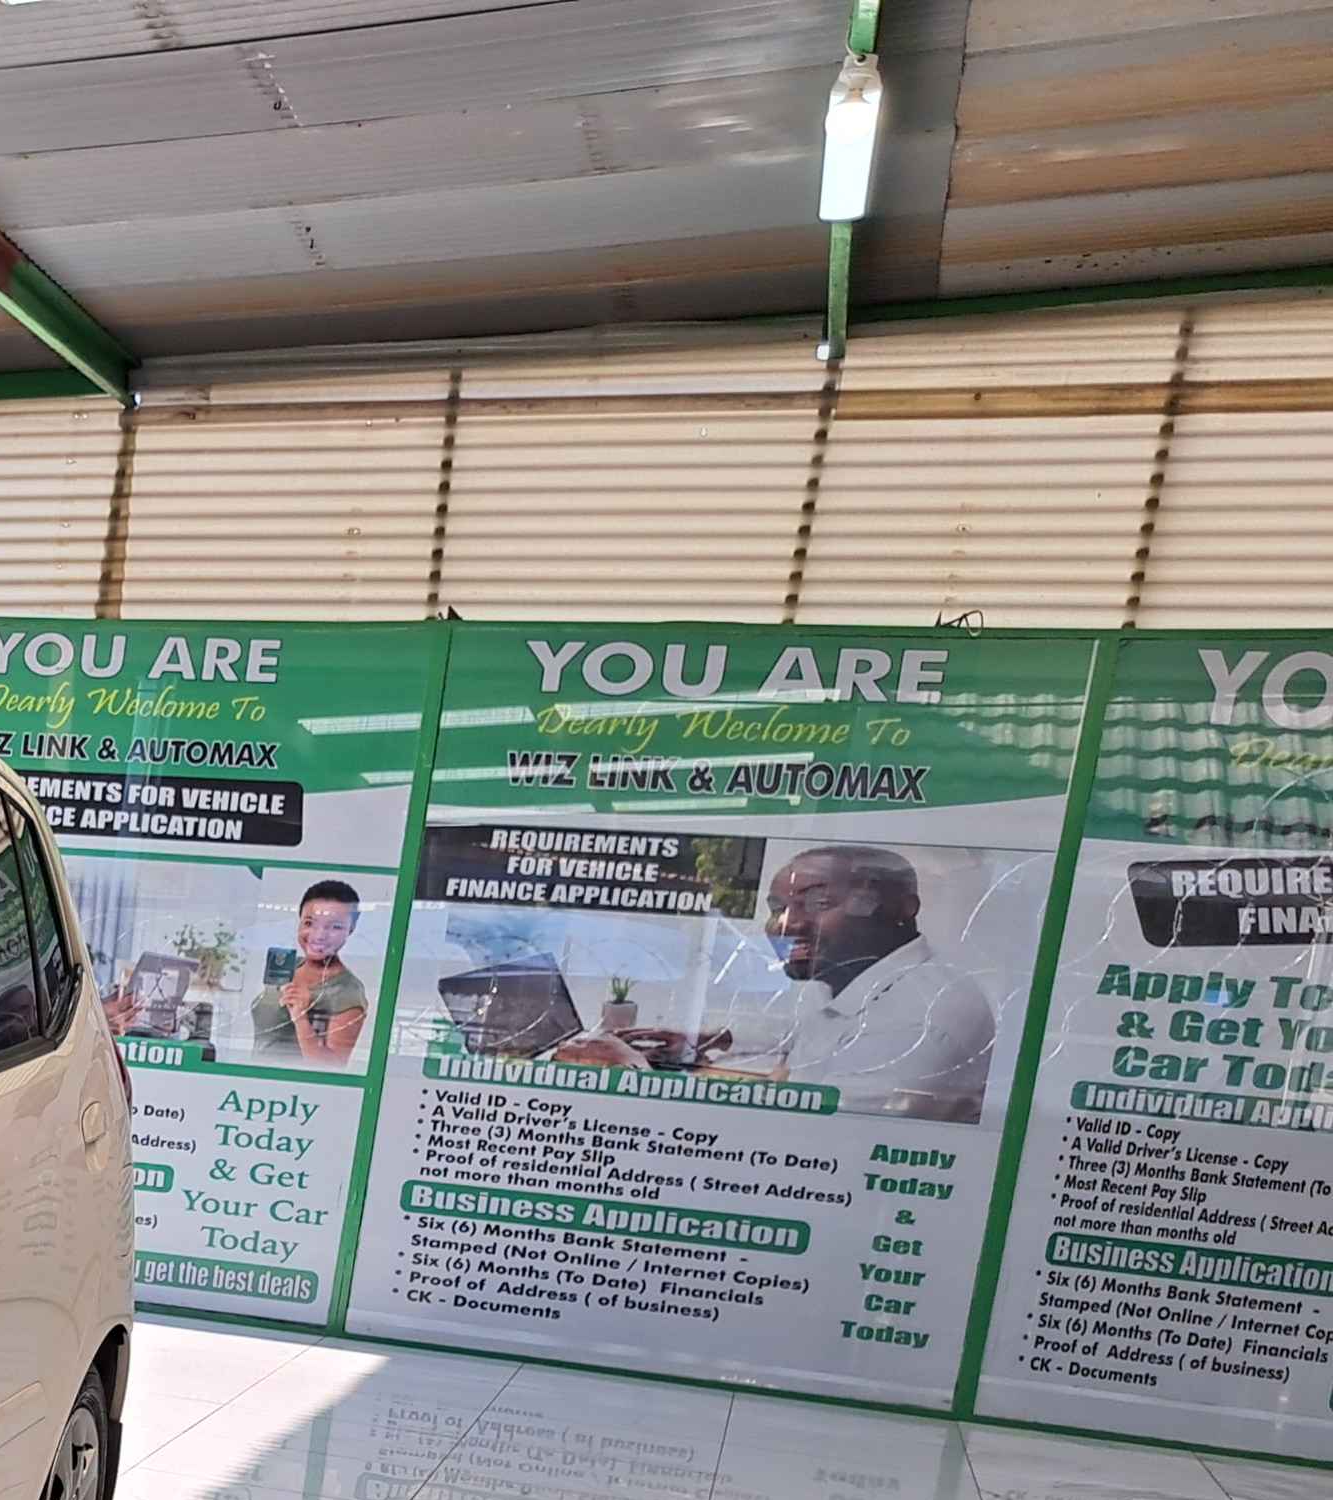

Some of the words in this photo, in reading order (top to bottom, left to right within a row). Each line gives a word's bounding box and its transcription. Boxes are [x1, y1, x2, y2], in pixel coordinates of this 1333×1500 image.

[148, 637, 282, 683] ARE
[527, 640, 729, 698] YOU
[758, 646, 950, 704] ARE
[86, 685, 221, 720] Weclome
[231, 696, 266, 721] To
[536, 702, 660, 753] Dearly
[676, 704, 850, 746] Weclome
[866, 717, 911, 747] To
[22, 734, 90, 759] LINK
[97, 737, 119, 762] &
[127, 738, 281, 769] AUTOMAX
[21, 775, 123, 804] EMENTS
[128, 783, 176, 807] FOR
[181, 787, 286, 816] VEHICLE
[507, 750, 580, 788] WIZ
[587, 753, 678, 793] LINK
[687, 763, 715, 794] &
[725, 758, 931, 803] AUTOMAX
[79, 807, 243, 842] APPLICATION
[489, 828, 680, 858] REQUIREMENTS
[506, 856, 553, 877] FOR
[558, 858, 660, 883] VEHICLE
[445, 878, 547, 902] FINANCE
[550, 883, 713, 913] APPLICATION
[1096, 963, 1256, 1009] Apply
[1117, 1010, 1155, 1039] &
[1168, 1009, 1265, 1048] Get
[1112, 1045, 1209, 1083] Car
[435, 1089, 482, 1106] Valid
[487, 1094, 507, 1108] ID
[527, 1098, 572, 1117] Copy
[438, 1056, 609, 1092] Individual
[616, 1067, 823, 1113] Application
[1085, 1083, 1245, 1121] Individual
[144, 1103, 186, 1122] Date)
[217, 1089, 320, 1126] Apply
[432, 1105, 445, 1118] A
[452, 1105, 498, 1123] Valid
[582, 1118, 651, 1138] License
[672, 1127, 718, 1147] Copy
[214, 1123, 315, 1160] Today
[430, 1119, 482, 1137] Three
[487, 1125, 512, 1142] (3)
[517, 1127, 585, 1146] Months
[591, 1135, 640, 1152] Bank
[646, 1140, 744, 1162] Statement
[750, 1150, 778, 1167] (To
[784, 1153, 838, 1175] Date)
[1076, 1116, 1113, 1134] Valid
[1114, 1120, 1132, 1136] ID
[1146, 1123, 1181, 1145] Copy
[427, 1133, 471, 1150] Most
[476, 1139, 537, 1157] Recent
[542, 1145, 576, 1164] Pay
[580, 1149, 616, 1167] Slip
[870, 1143, 957, 1170] Apply
[1070, 1135, 1082, 1151] A
[1086, 1137, 1123, 1155] Valid
[1185, 1147, 1238, 1167] License
[1254, 1153, 1290, 1176] Copy
[209, 1158, 238, 1182] &
[249, 1162, 310, 1190] Get
[419, 1167, 449, 1178] not
[454, 1170, 502, 1184] more
[507, 1172, 550, 1189] than
[555, 1180, 624, 1197] months
[630, 1185, 660, 1200] old
[425, 1149, 474, 1165] Proof
[484, 1154, 498, 1168] of
[502, 1159, 602, 1179] residential
[606, 1167, 684, 1187] Address
[702, 1177, 760, 1195] Street
[764, 1183, 852, 1207] Address)
[863, 1173, 954, 1200] Today
[1063, 1173, 1098, 1191] Most
[1100, 1177, 1148, 1197] Recent
[1150, 1183, 1177, 1203] Pay
[1179, 1185, 1207, 1207] Slip
[1068, 1155, 1108, 1173] Three
[1111, 1159, 1131, 1179] (3)
[1134, 1161, 1186, 1181] Months
[1190, 1167, 1228, 1186] Bank
[1231, 1171, 1307, 1193] Statement
[1309, 1179, 1332, 1198] (To
[181, 1188, 259, 1218] Your
[269, 1199, 329, 1227] Car
[409, 1184, 575, 1225] Business
[580, 1202, 800, 1249] Application
[894, 1209, 916, 1225] &
[200, 1225, 300, 1264] Today
[417, 1216, 445, 1231] Six
[451, 1219, 477, 1237] (6)
[483, 1223, 556, 1243] Months
[562, 1231, 615, 1250] Bank
[622, 1238, 727, 1263] Statement
[871, 1234, 924, 1257] Get
[1051, 1236, 1175, 1276] Business
[144, 1259, 175, 1285] get
[179, 1261, 208, 1287] the
[212, 1265, 255, 1293] best
[258, 1271, 312, 1300] deals
[410, 1233, 498, 1255] Stamped
[503, 1244, 547, 1261] (Not
[553, 1250, 621, 1270] Online
[643, 1260, 726, 1282] Internet
[732, 1270, 810, 1295] Copies)
[412, 1252, 440, 1268] Six
[445, 1256, 471, 1275] (6)
[477, 1260, 550, 1280] Months
[556, 1269, 585, 1285] (To
[592, 1273, 647, 1295] Date)
[660, 1281, 764, 1306] Financials
[859, 1263, 926, 1286] Your
[406, 1289, 432, 1304] CK
[453, 1294, 561, 1320] Documents
[409, 1271, 467, 1291] Proof
[468, 1278, 486, 1291] of
[496, 1281, 578, 1303] Address
[598, 1293, 619, 1307] of
[624, 1295, 720, 1323] business)
[864, 1294, 917, 1316] Car
[840, 1320, 930, 1349] Today
[1030, 1356, 1052, 1373] CK
[1068, 1361, 1158, 1387] Documents
[1033, 1335, 1078, 1354] Proof
[1081, 1341, 1100, 1357] of
[1106, 1344, 1174, 1367] Address
[1190, 1355, 1208, 1370] of
[1210, 1356, 1290, 1385] business)
